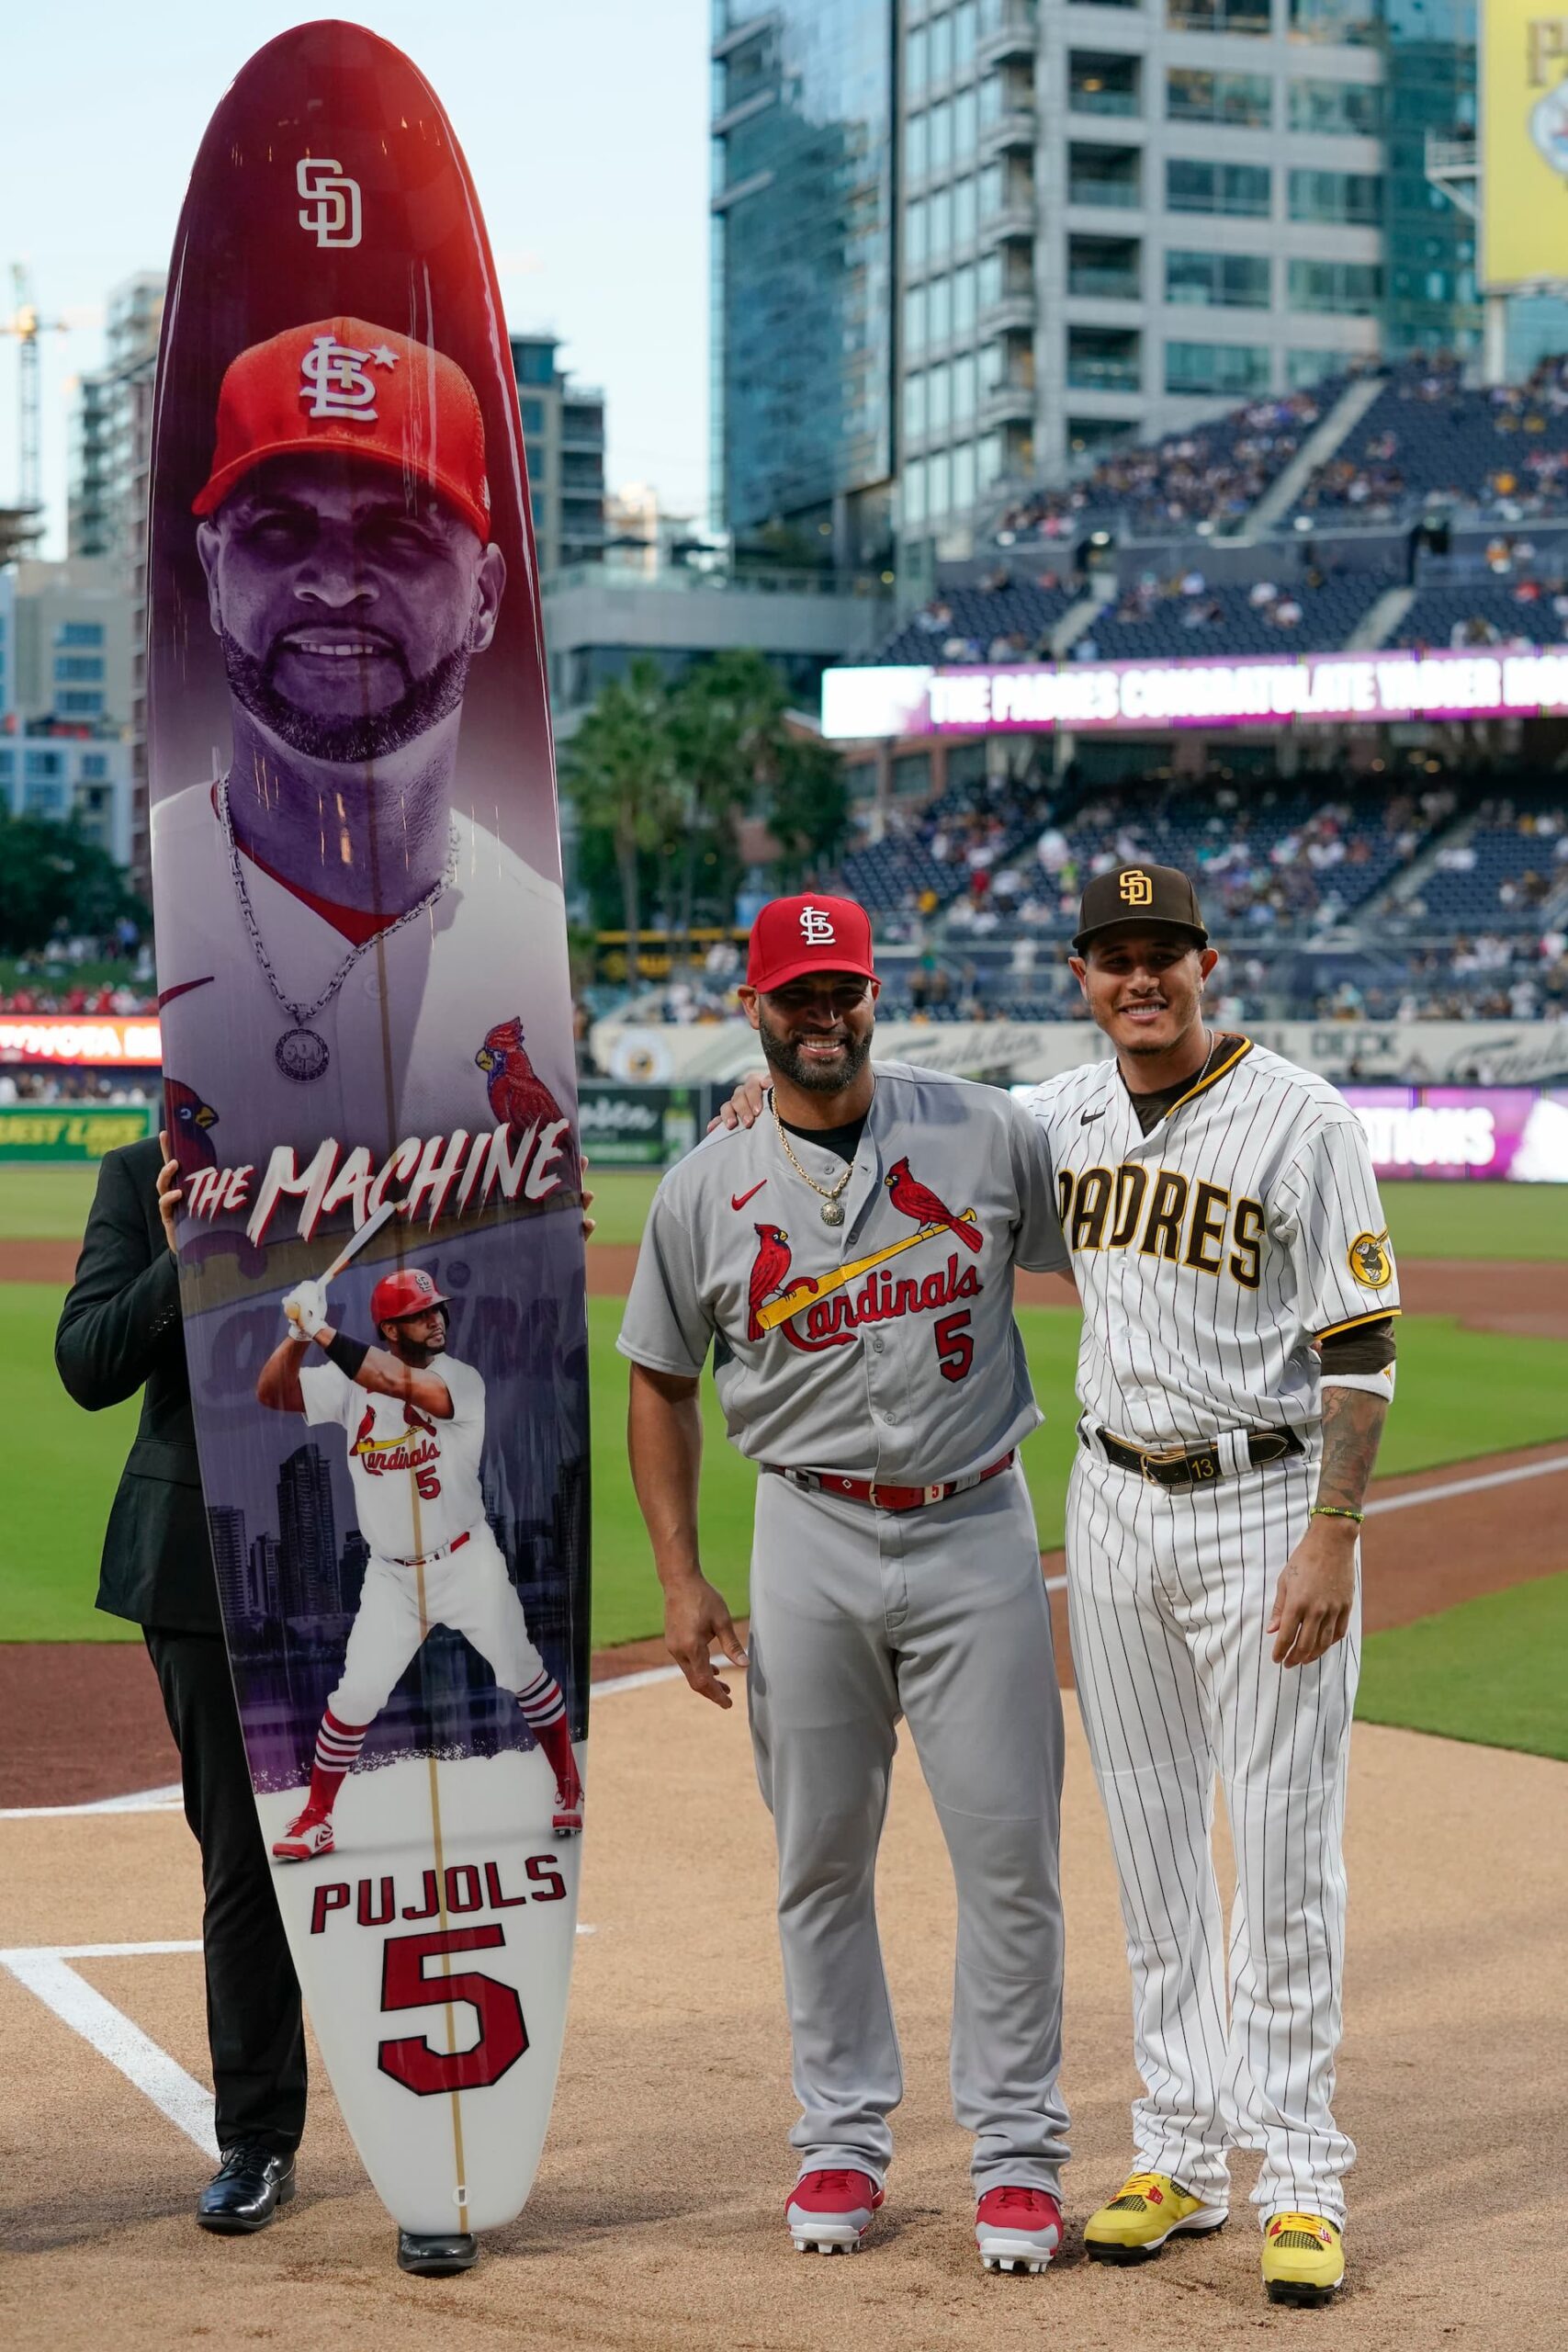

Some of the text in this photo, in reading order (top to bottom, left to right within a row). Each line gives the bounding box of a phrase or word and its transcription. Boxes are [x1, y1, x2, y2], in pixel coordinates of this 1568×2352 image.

[296, 158, 362, 248] SD
[1119, 870, 1153, 906] SD
[184, 1164, 254, 1224] THE
[246, 1114, 570, 1249] MACHINE
[1058, 1162, 1267, 1292] PADRES
[779, 1252, 984, 1352] Cardinals
[934, 1308, 975, 1383] 5
[361, 1437, 441, 1476] Cardinals
[415, 1464, 442, 1500] 5
[931, 1484, 940, 1499] 5
[1191, 1458, 1214, 1479] 13
[310, 1853, 567, 1934] PUJOLS
[378, 1923, 530, 2097] 5
